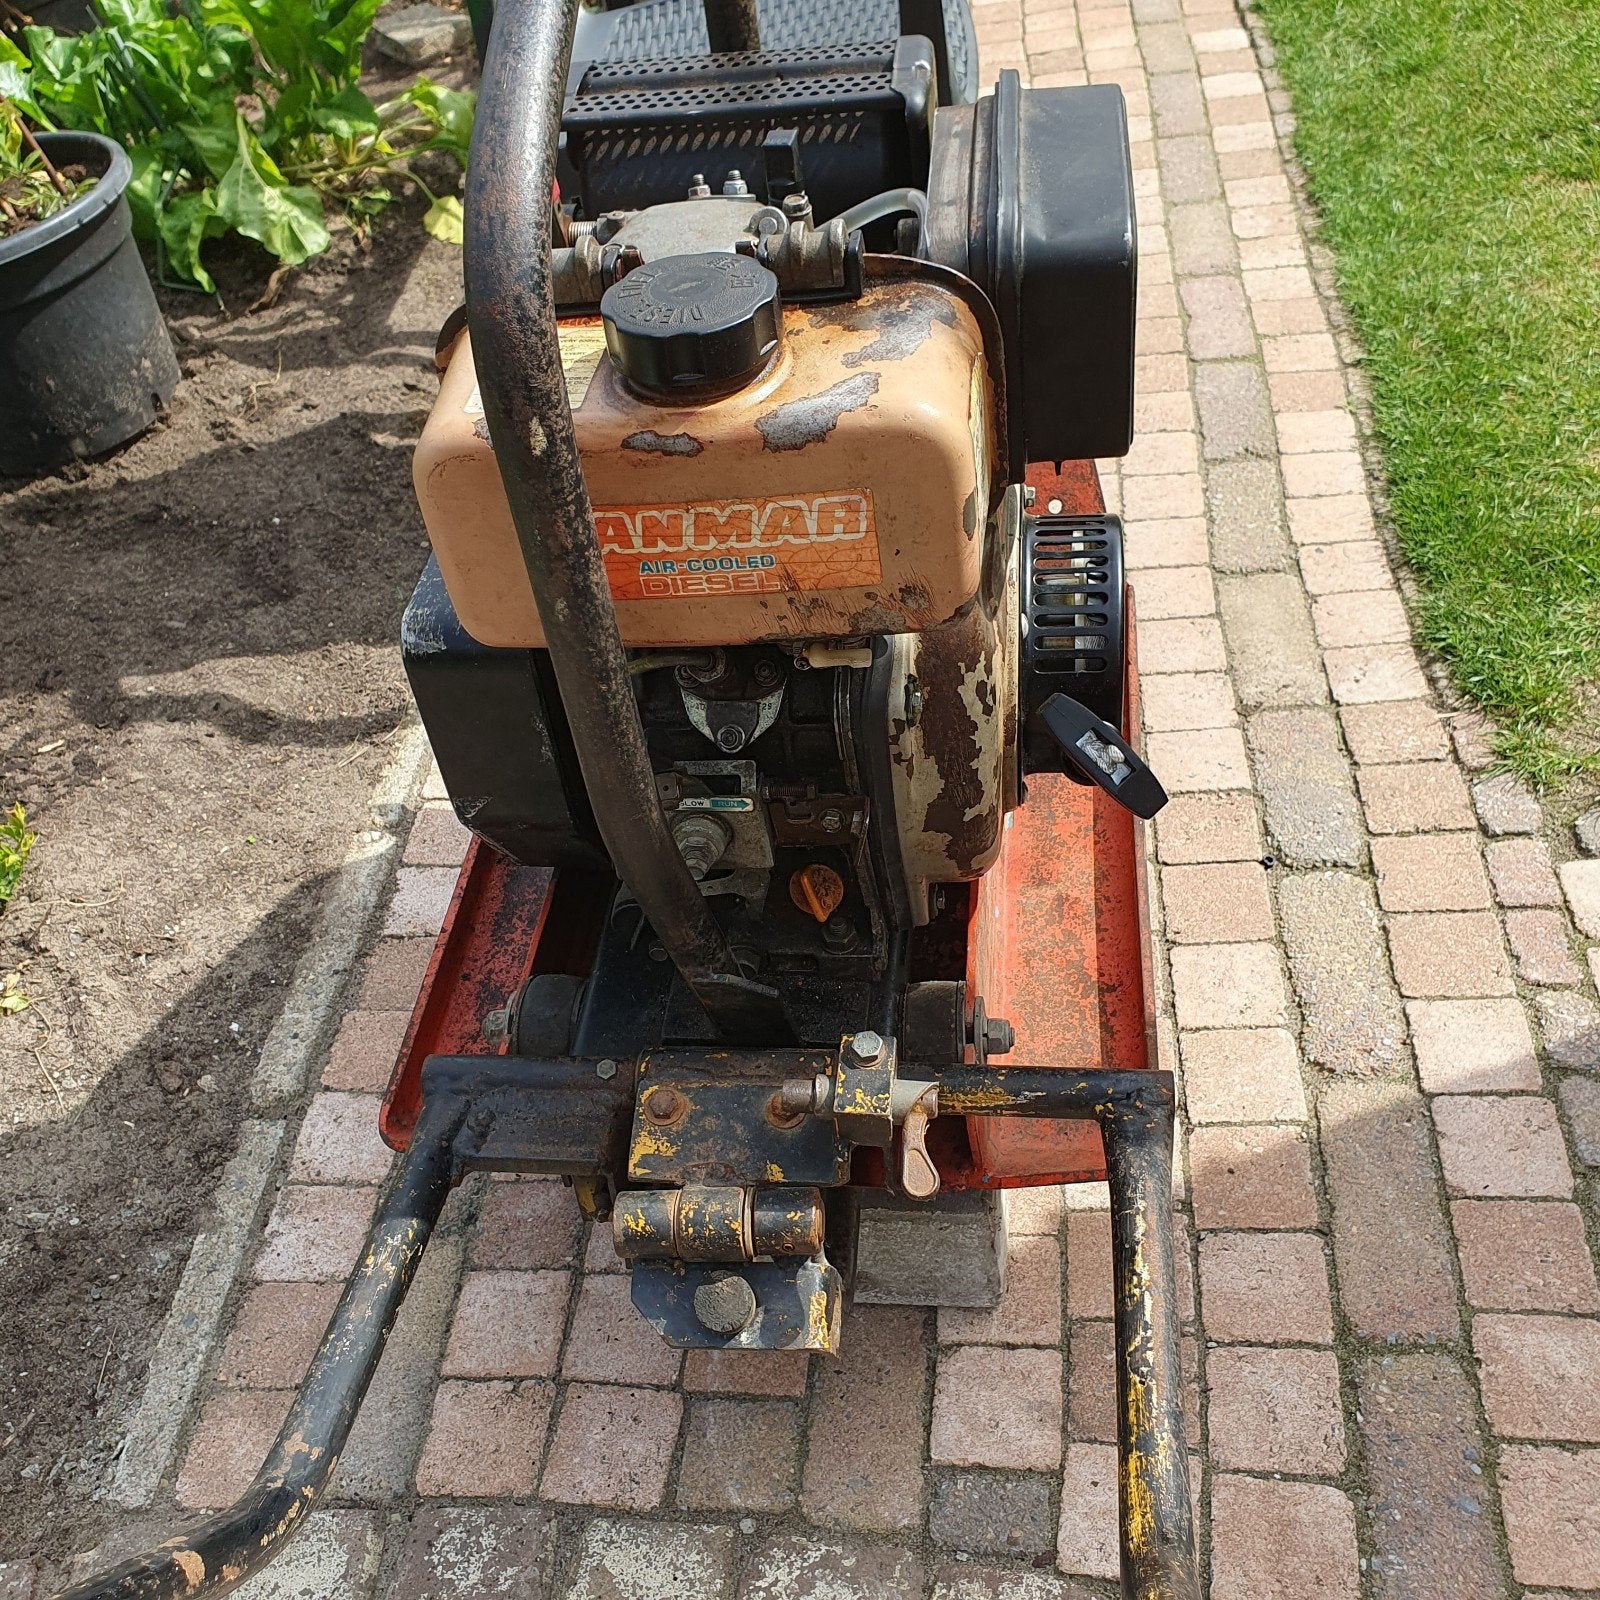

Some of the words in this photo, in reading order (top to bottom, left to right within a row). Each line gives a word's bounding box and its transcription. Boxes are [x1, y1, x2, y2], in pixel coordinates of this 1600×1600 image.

[594, 494, 868, 554] ANMAR
[639, 554, 776, 576] AIR-COOLED
[640, 571, 781, 597] DIESEL
[717, 800, 738, 808] RUN
